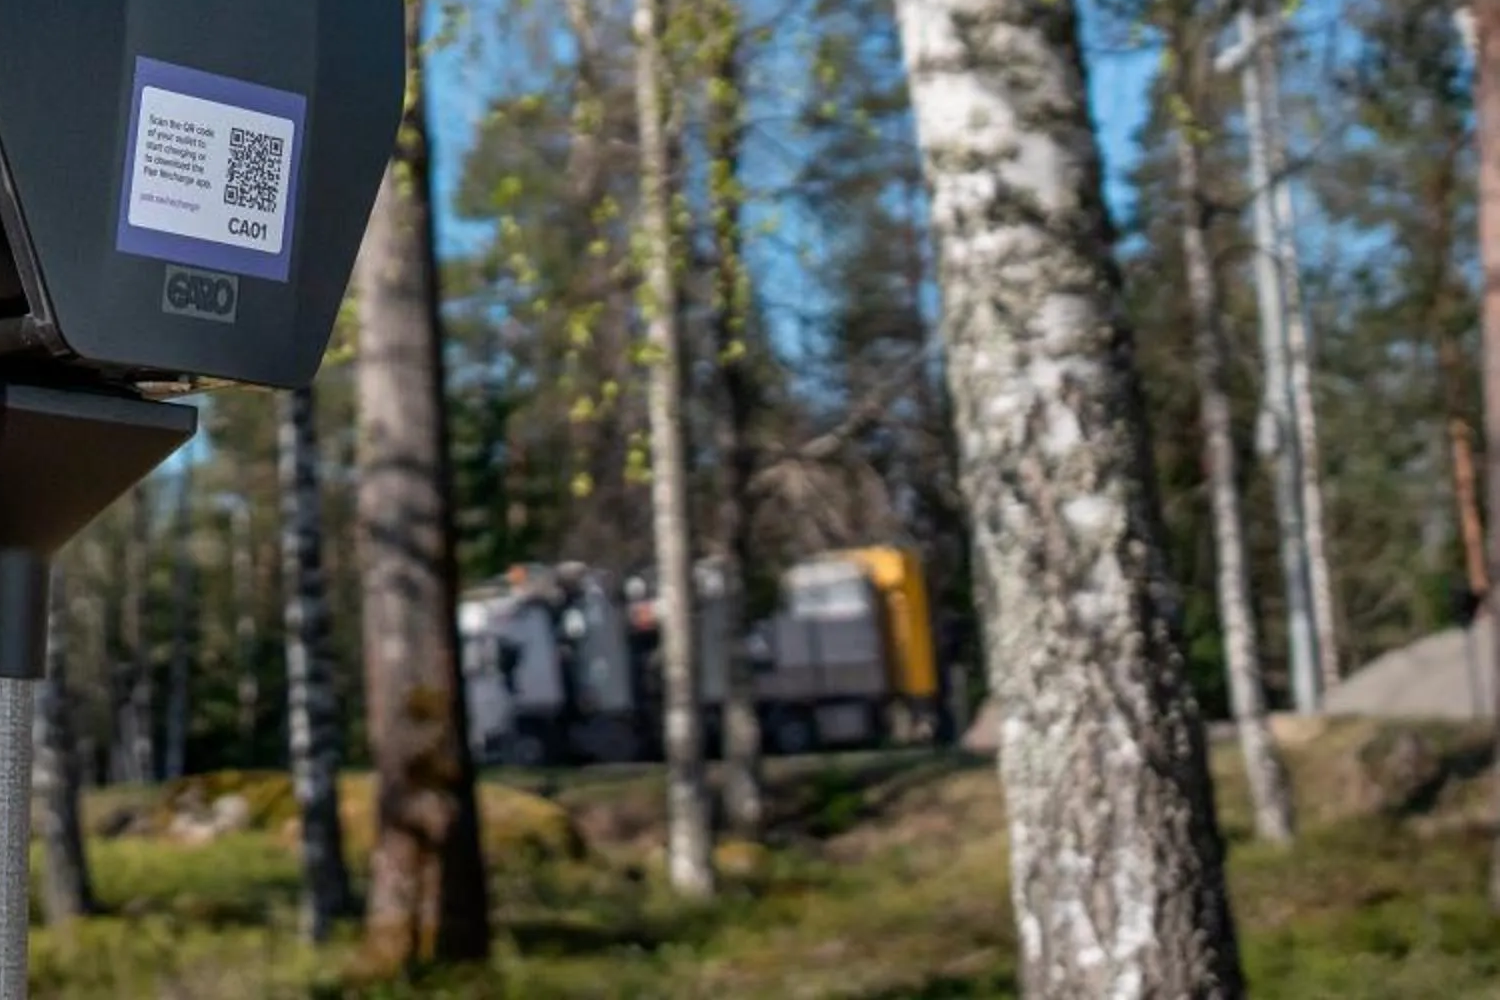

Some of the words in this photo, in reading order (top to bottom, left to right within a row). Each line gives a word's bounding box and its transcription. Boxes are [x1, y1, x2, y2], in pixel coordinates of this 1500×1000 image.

[150, 113, 168, 127] Scan
[169, 118, 183, 130] the
[183, 121, 195, 133] QR
[195, 124, 215, 137] code
[148, 128, 156, 137] of
[157, 132, 175, 143] your
[175, 134, 197, 147] outlet
[198, 139, 206, 148] to
[146, 141, 163, 151] start
[163, 145, 197, 161] charging
[198, 153, 206, 161] or
[144, 154, 153, 163] to
[154, 157, 191, 171] download
[192, 162, 205, 174] the
[143, 166, 158, 177] Pair
[159, 168, 195, 186] Recharge
[228, 217, 268, 241] CA01
